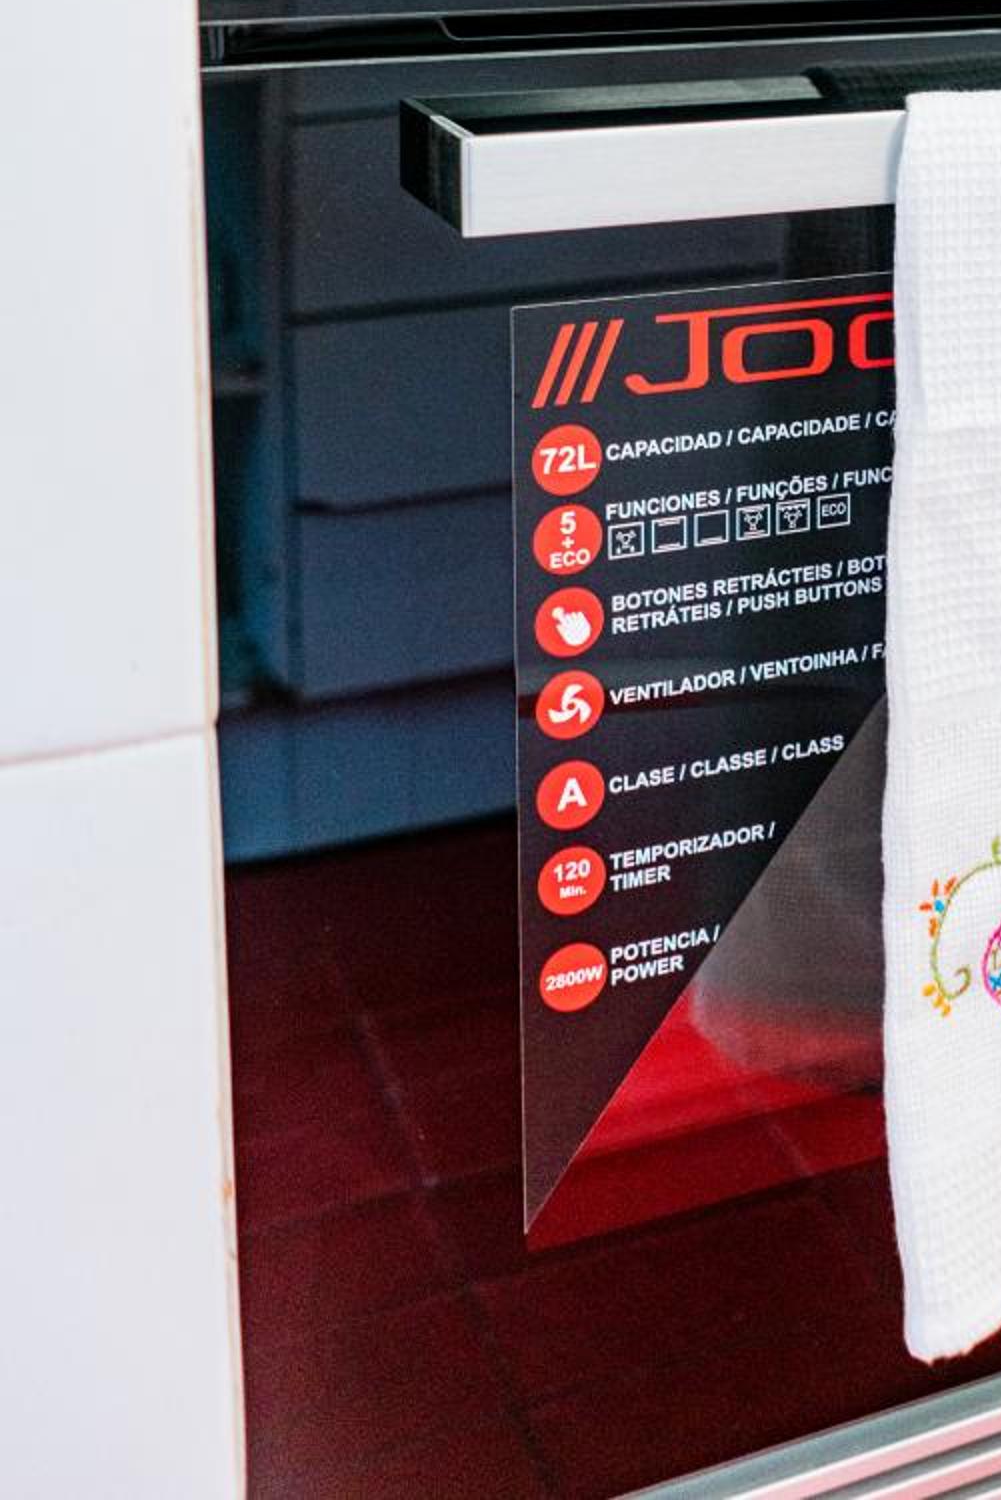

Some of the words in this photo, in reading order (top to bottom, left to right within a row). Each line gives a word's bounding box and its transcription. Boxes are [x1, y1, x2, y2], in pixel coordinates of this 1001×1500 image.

[605, 430, 722, 461] CAPACIDAD
[737, 414, 861, 445] CAPACIDADE
[540, 446, 597, 474] 72L
[605, 489, 721, 521] FUNCIONES
[736, 474, 828, 501] FUNÇÕES
[820, 501, 847, 517] ECO
[560, 512, 577, 534] 5
[549, 549, 591, 568] ECO
[611, 581, 707, 613] BOTONES
[713, 564, 832, 596] RETRÁCTEIS
[847, 555, 887, 575] BOT
[611, 602, 722, 634] RETRÁTEIS
[738, 592, 790, 614] PUSH
[795, 576, 883, 605] BUTTONS
[609, 670, 736, 705] VENTILADOR
[750, 648, 857, 682] VENTOINHA
[609, 765, 675, 794] CLASE
[691, 749, 767, 777] CLASSE
[781, 735, 845, 762] CLASS
[557, 778, 587, 812] A
[609, 825, 765, 870] TEMPORIZADOR
[553, 859, 591, 881] 120
[610, 865, 671, 892] TIMER
[559, 885, 587, 899] Min.
[610, 928, 710, 963] POTENCIA
[545, 965, 603, 991] 2800W
[610, 955, 684, 986] POWER
